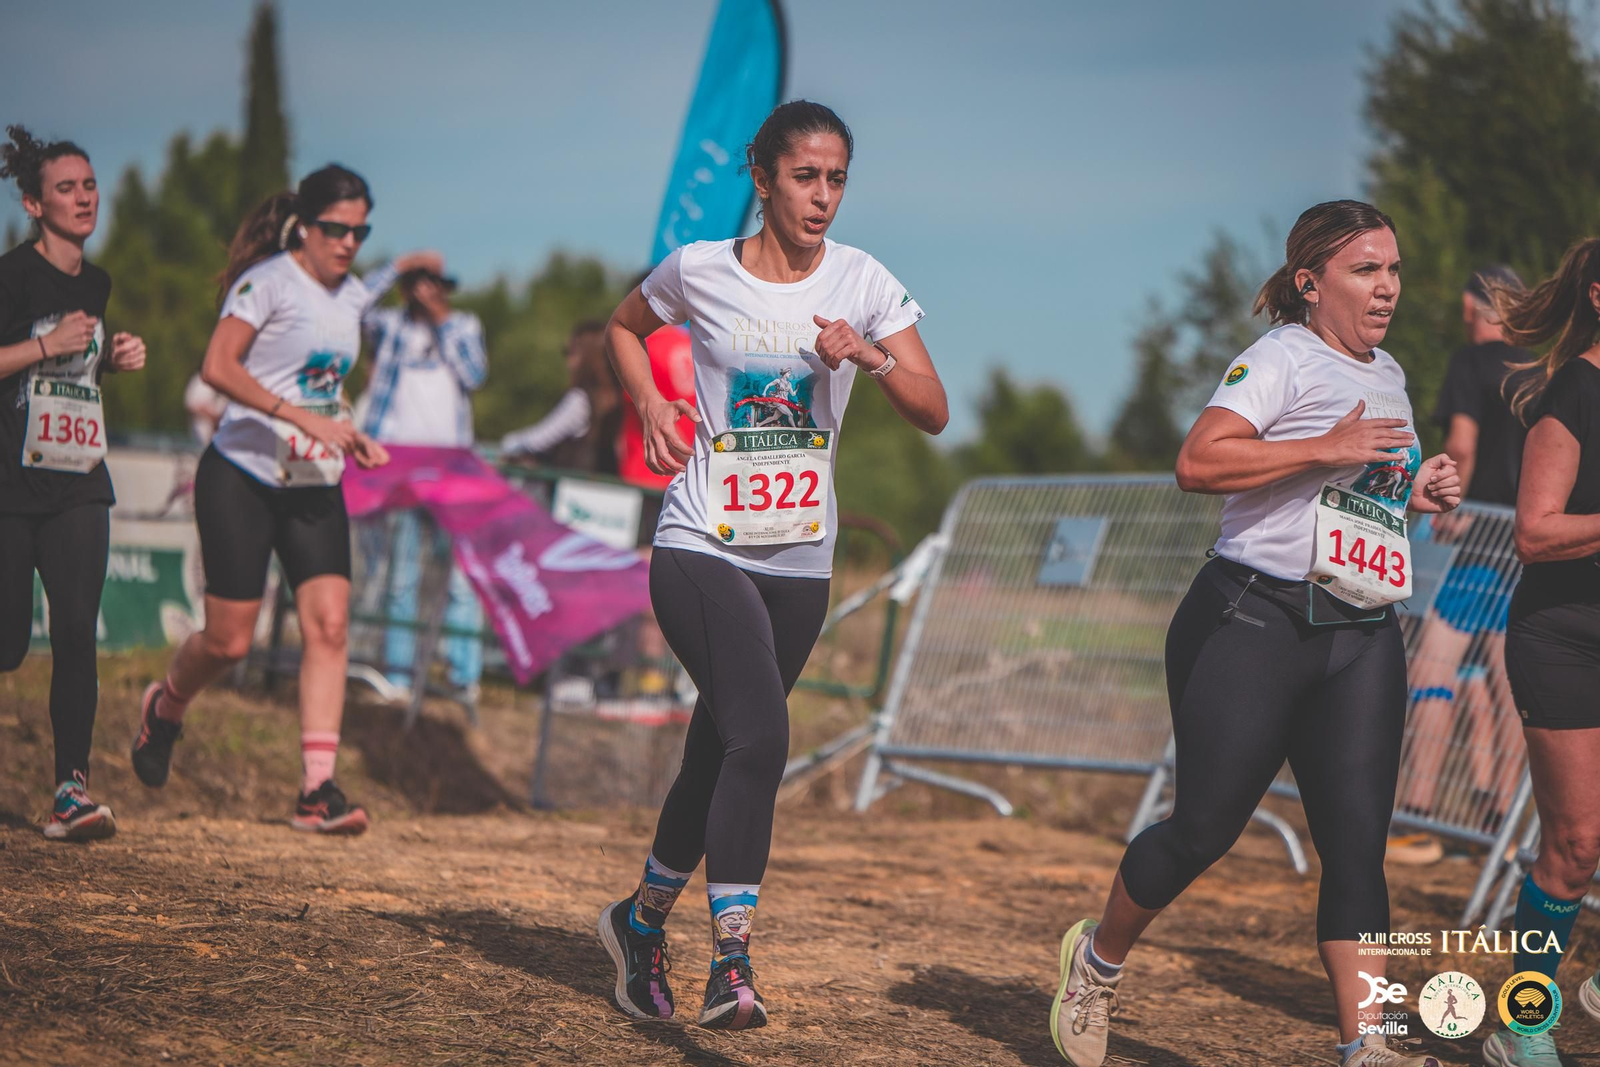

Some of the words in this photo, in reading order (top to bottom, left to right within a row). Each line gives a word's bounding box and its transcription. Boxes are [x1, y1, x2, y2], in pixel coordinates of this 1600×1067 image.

[734, 318, 776, 333] XLIII
[776, 321, 812, 331] CROSS
[37, 412, 102, 448] 1362
[743, 432, 798, 448] ITÁLICA
[723, 469, 820, 511] 1322
[1346, 497, 1388, 525] ITÁLICA
[1353, 523, 1386, 539] INDEPENDIENTE
[1329, 529, 1406, 588] 1443
